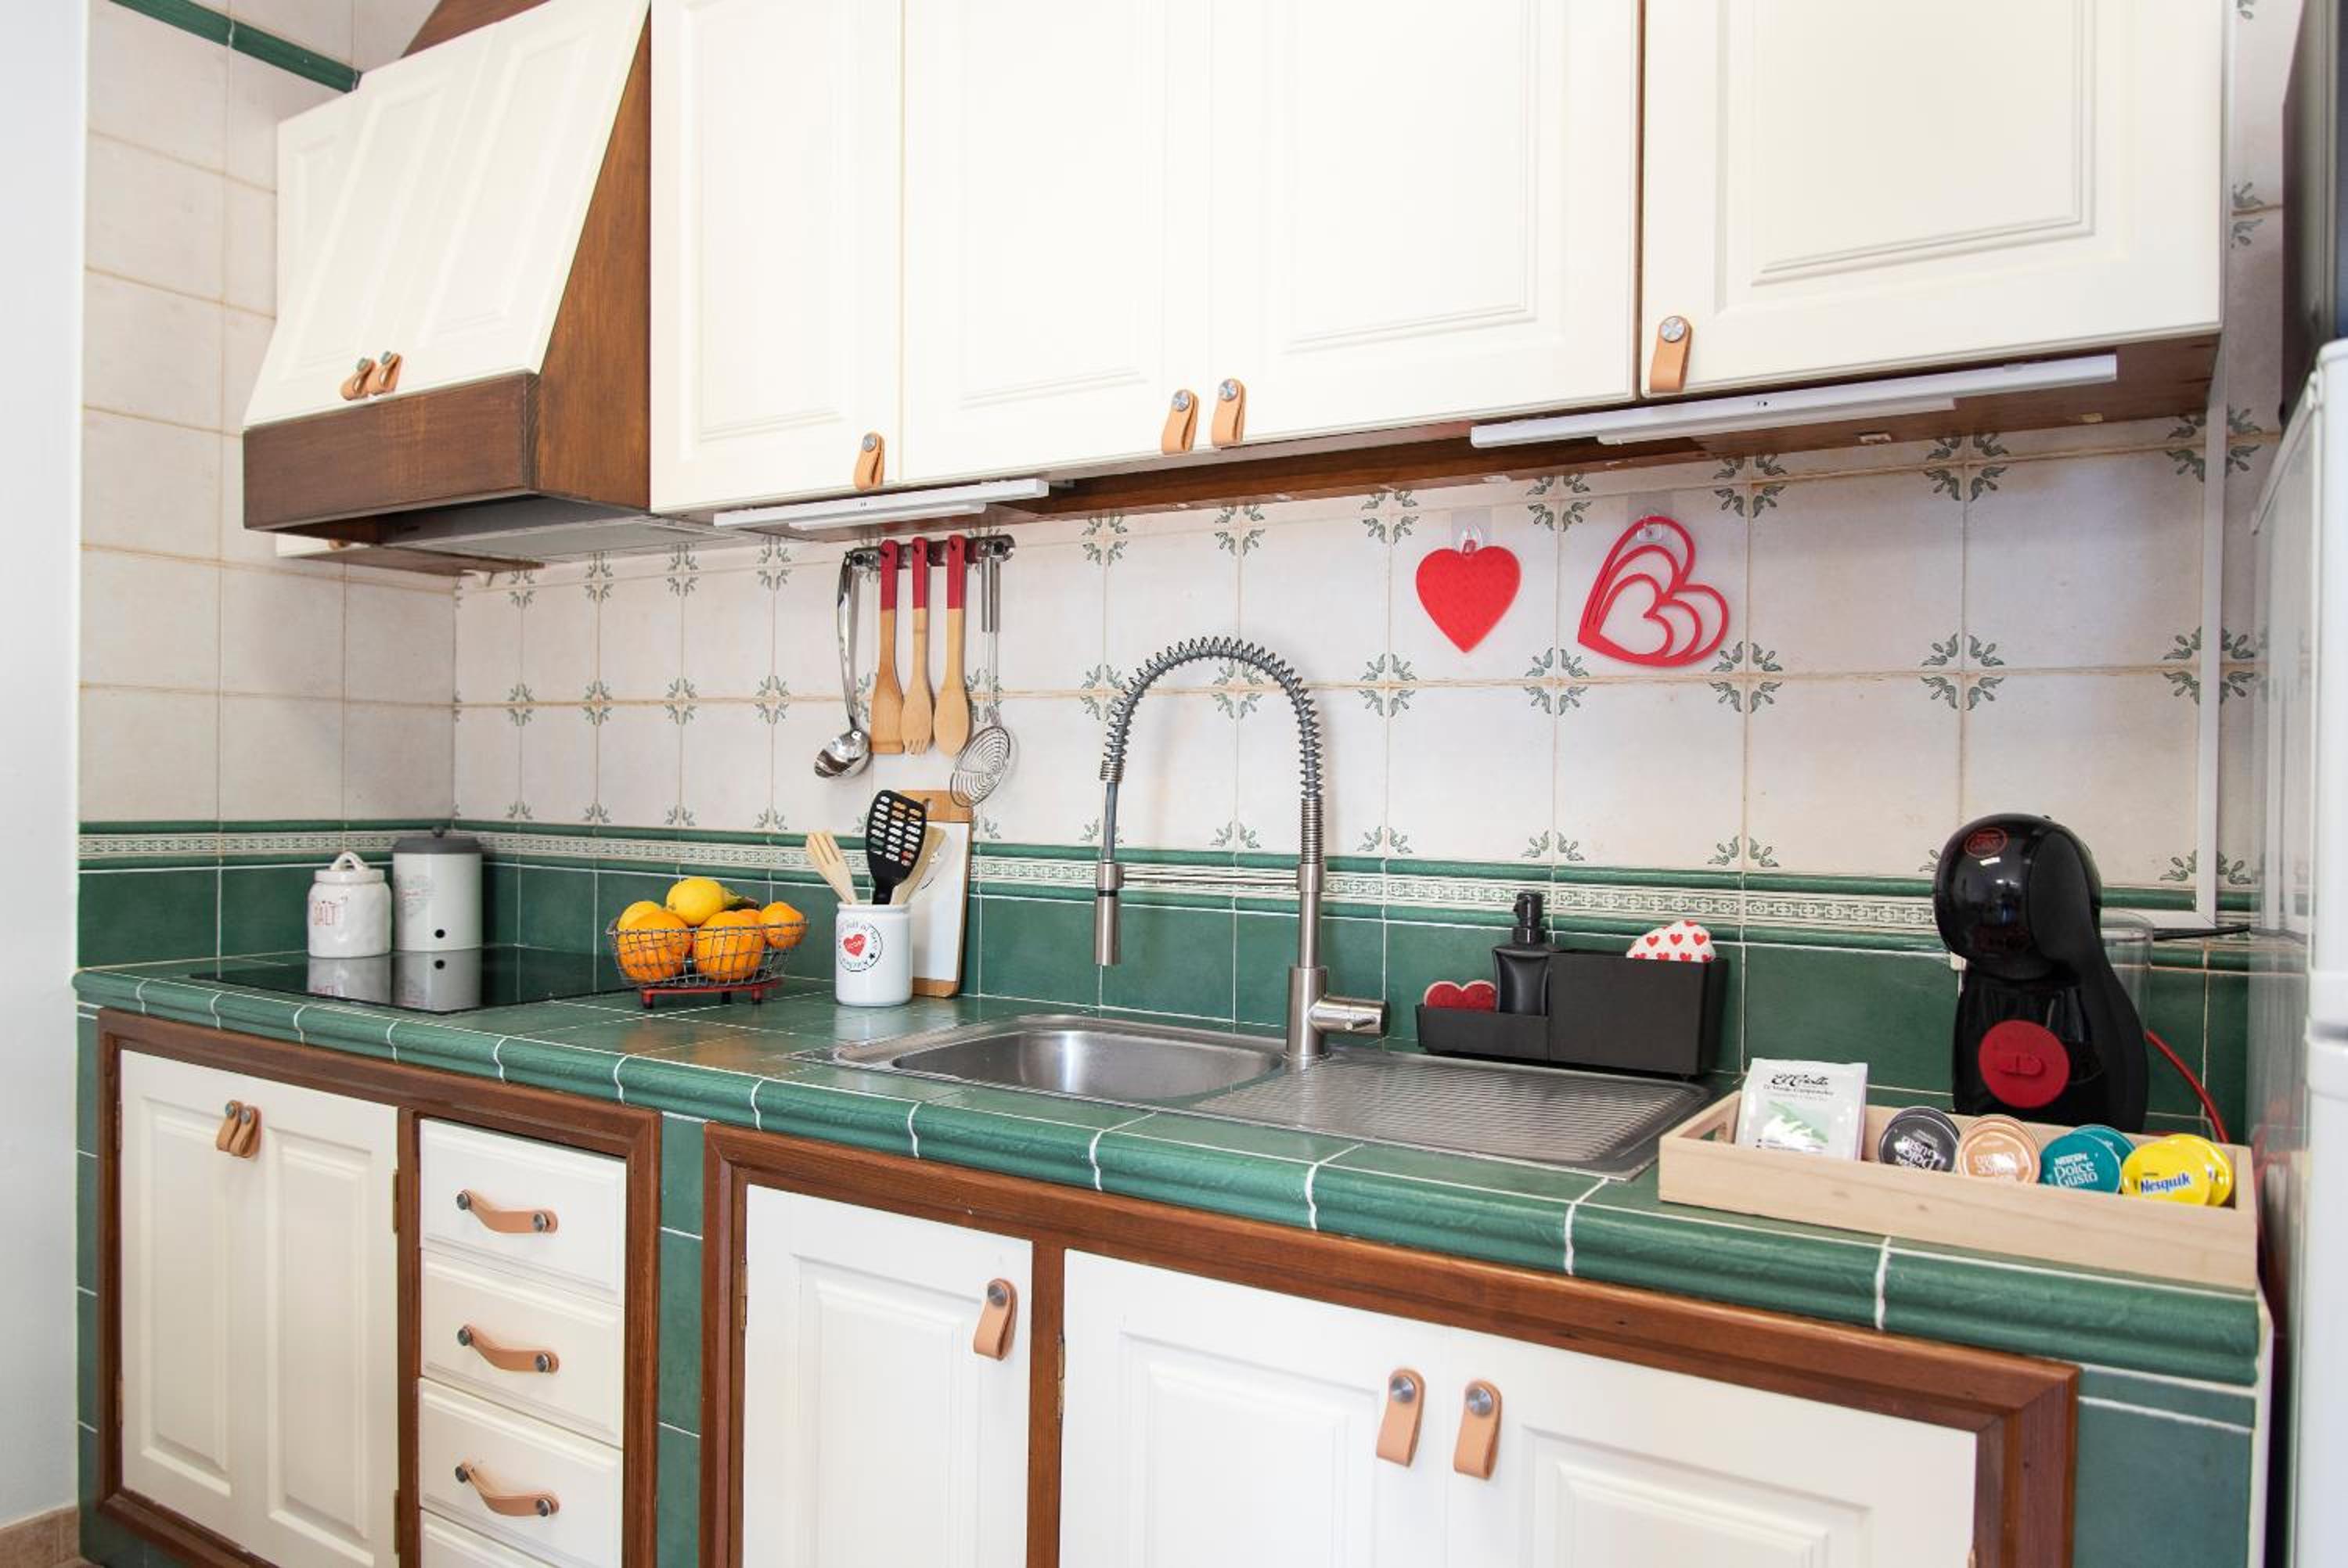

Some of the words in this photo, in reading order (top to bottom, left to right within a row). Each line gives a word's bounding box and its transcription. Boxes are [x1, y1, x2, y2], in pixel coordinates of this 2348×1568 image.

[2054, 1161, 2094, 1178] Dolce
[2057, 1171, 2098, 1187] Gusto
[2141, 1171, 2191, 1193] Nesquik
